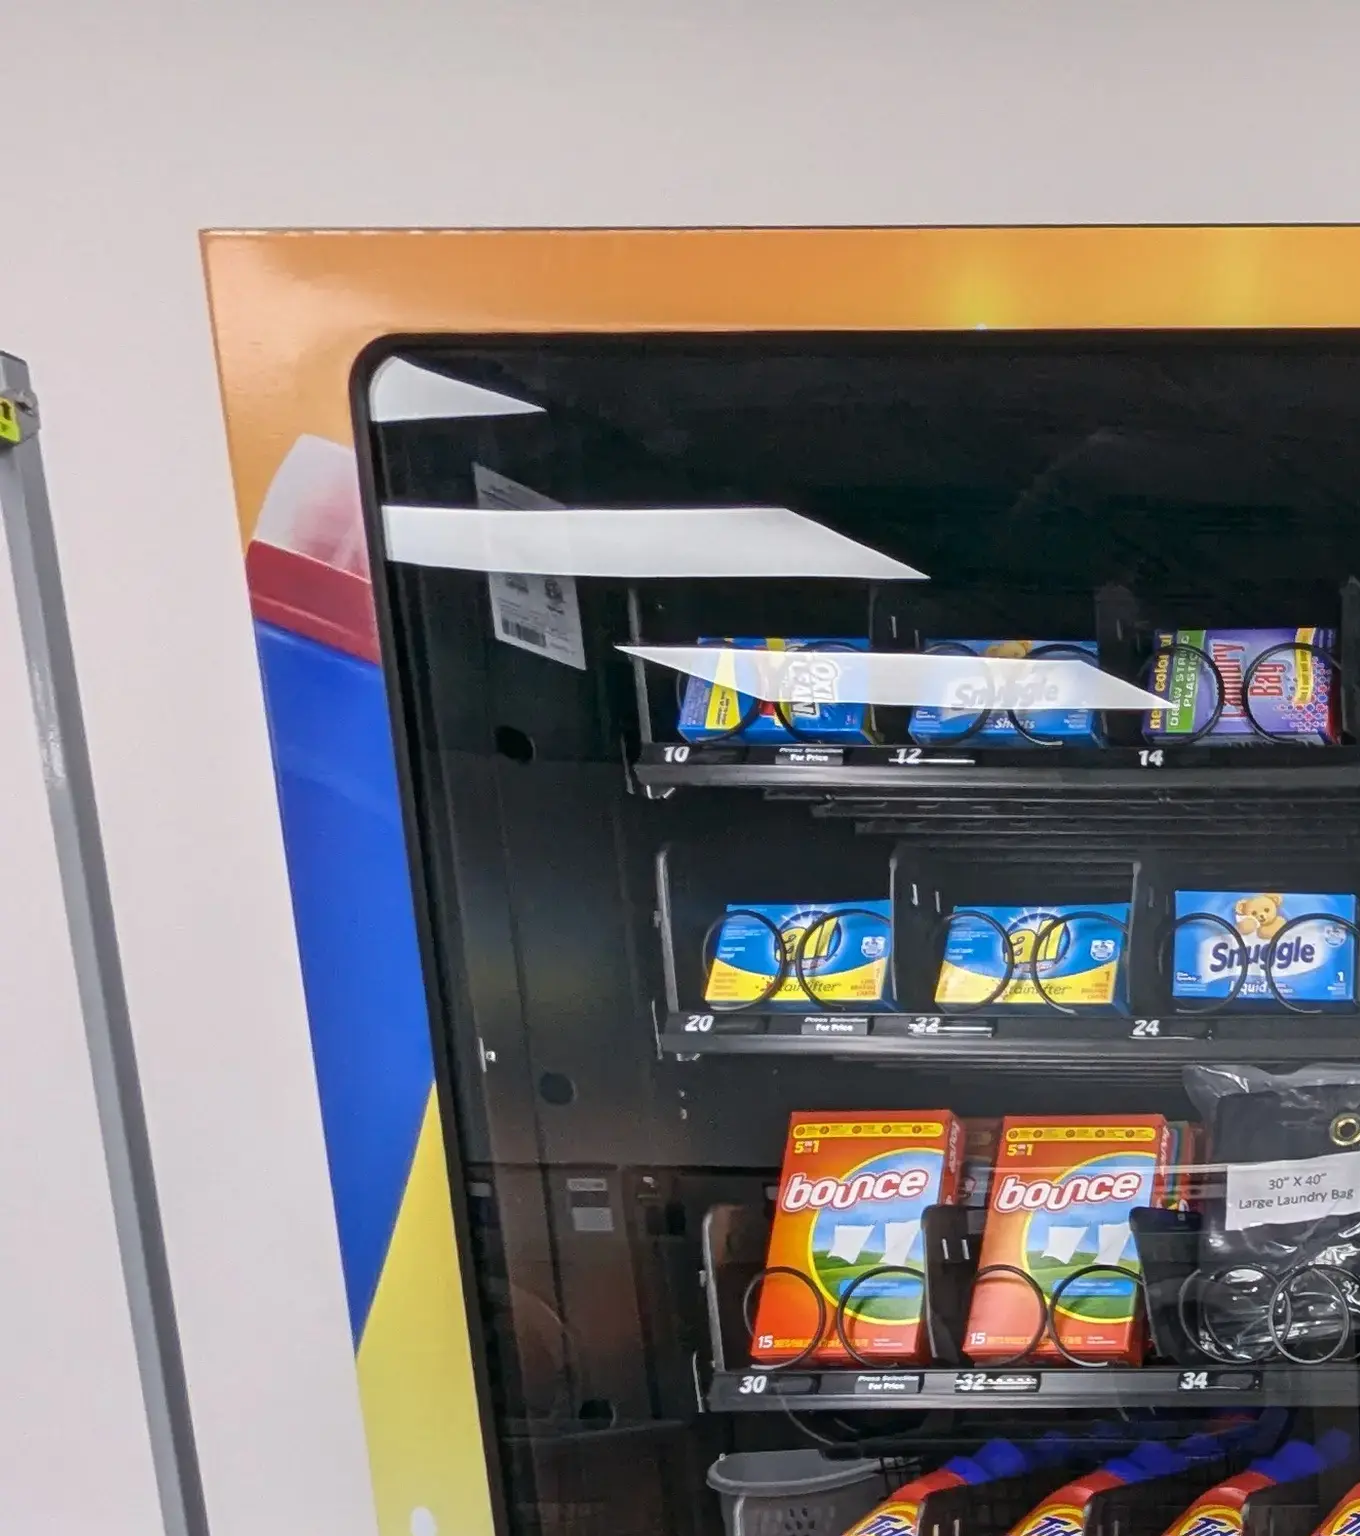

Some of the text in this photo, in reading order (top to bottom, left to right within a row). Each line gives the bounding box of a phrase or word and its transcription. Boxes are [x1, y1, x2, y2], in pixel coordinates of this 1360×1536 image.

[664, 747, 689, 762] 10
[1139, 751, 1164, 766] 14
[1210, 937, 1316, 973] Snuggle
[685, 1015, 713, 1031] 20
[1133, 1020, 1160, 1035] 24
[1293, 1176, 1301, 1187] X
[784, 1170, 928, 1210] bounce
[997, 1172, 1141, 1212] bounce
[1239, 1188, 1354, 1210] Large Laundry Bag
[758, 1336, 773, 1348] 15
[970, 1333, 986, 1344] 15
[739, 1377, 766, 1393] 30
[1180, 1372, 1208, 1390] 34
